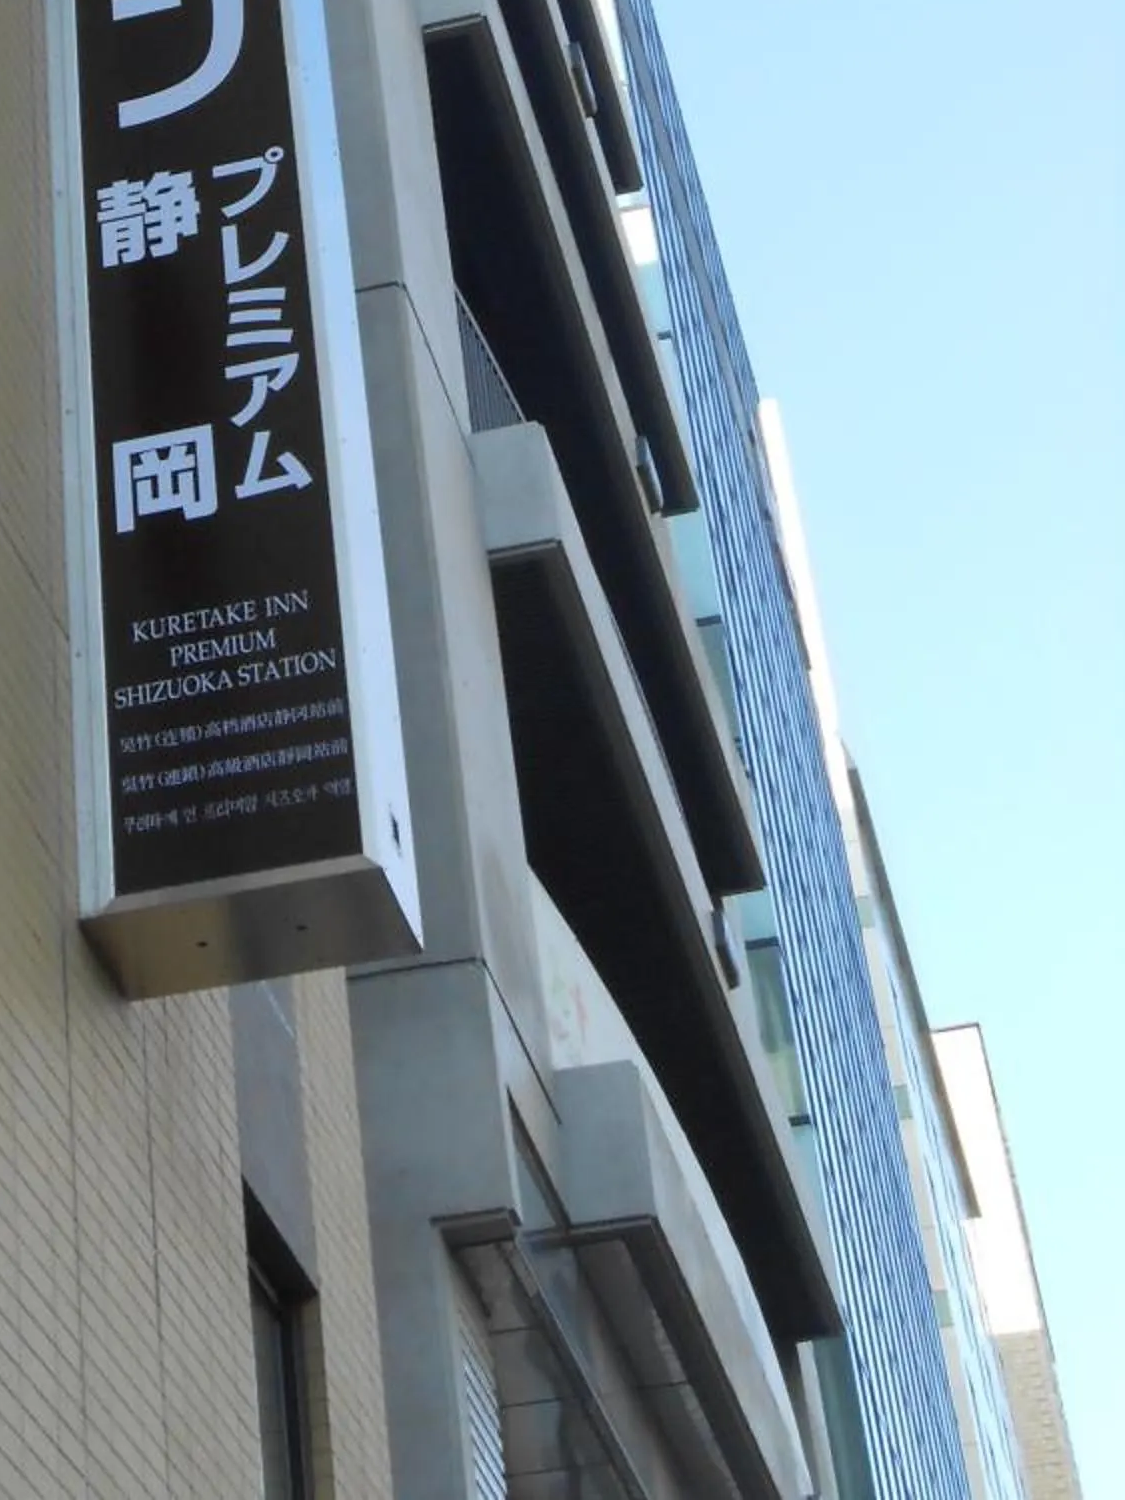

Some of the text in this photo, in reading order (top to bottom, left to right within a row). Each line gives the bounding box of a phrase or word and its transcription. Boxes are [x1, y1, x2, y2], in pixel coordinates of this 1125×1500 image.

[212, 146, 313, 500] プレミアム
[132, 589, 309, 643] KURETAKE INN
[170, 627, 276, 667] PREMIUM
[113, 648, 337, 709] SHIZUOKA STATION
